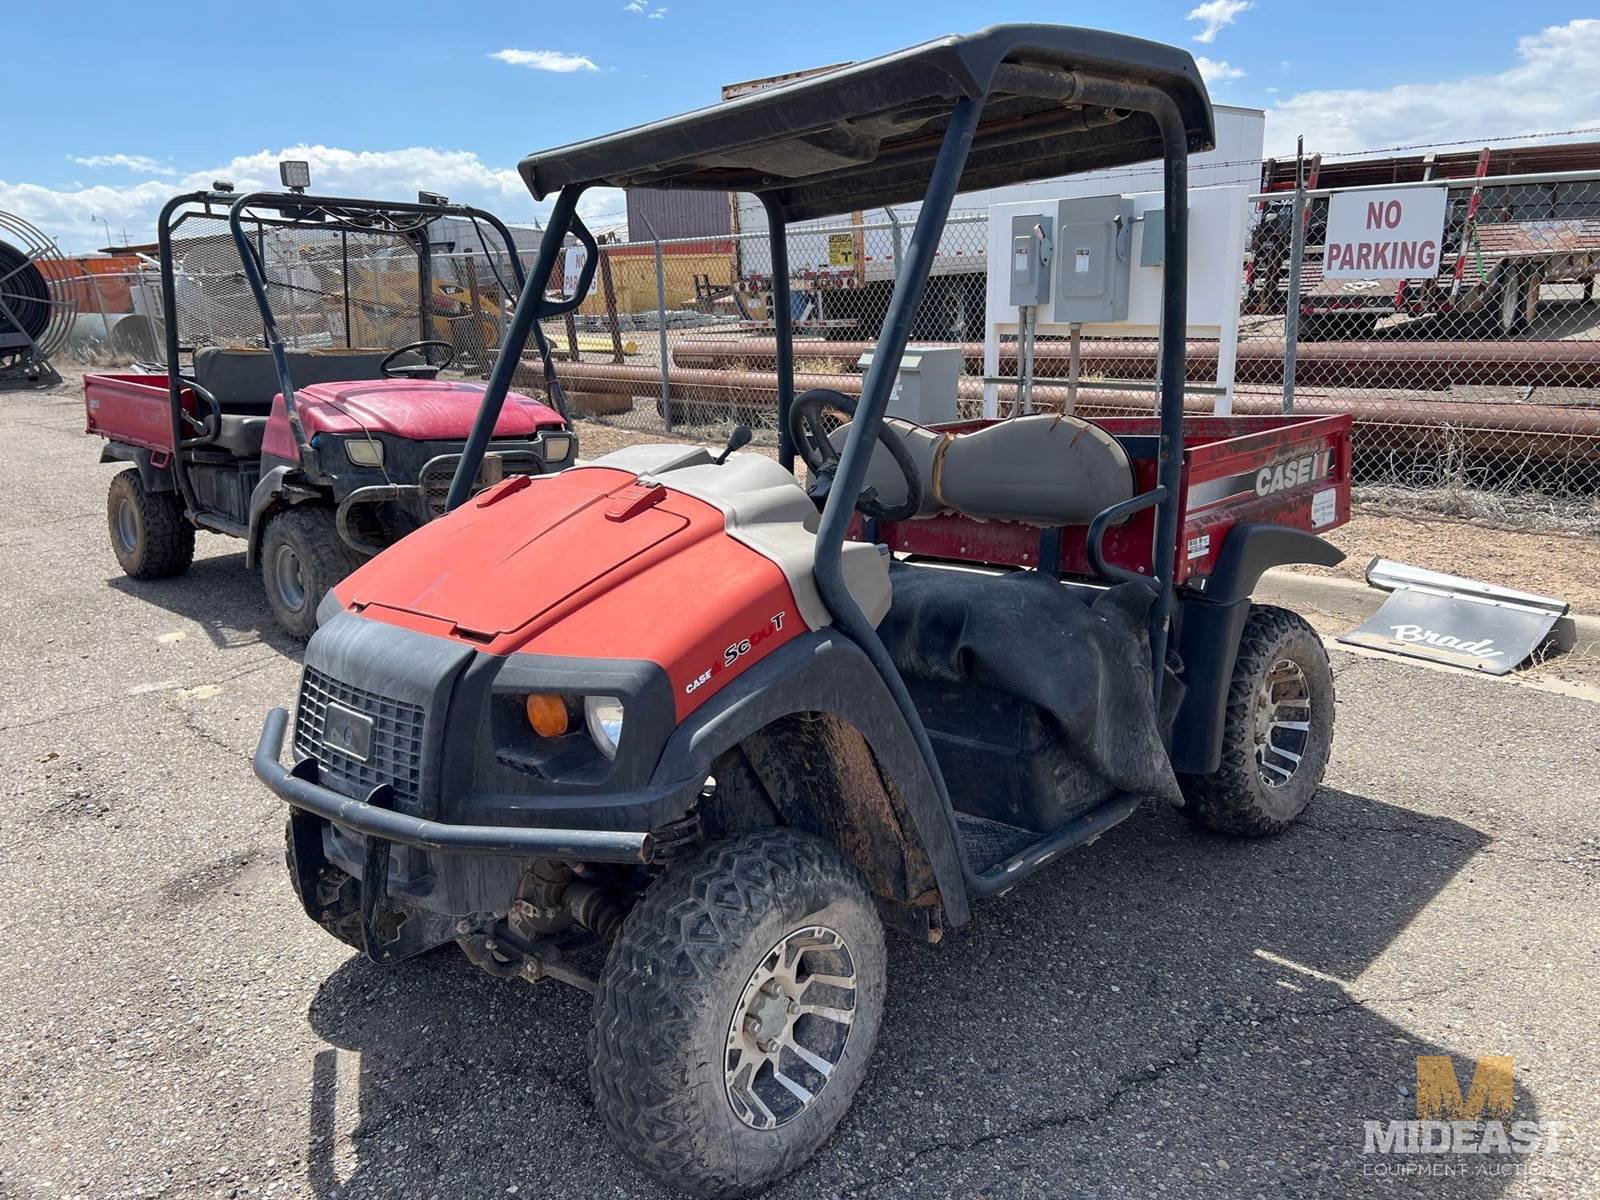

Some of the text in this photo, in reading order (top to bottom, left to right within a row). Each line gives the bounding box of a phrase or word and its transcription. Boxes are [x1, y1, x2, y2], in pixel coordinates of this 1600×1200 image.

[1366, 200, 1402, 229] NO
[575, 253, 586, 269] NO
[1326, 240, 1436, 271] PARKING
[685, 611, 785, 694] CASE SCOUT
[1389, 624, 1505, 659] Brady
